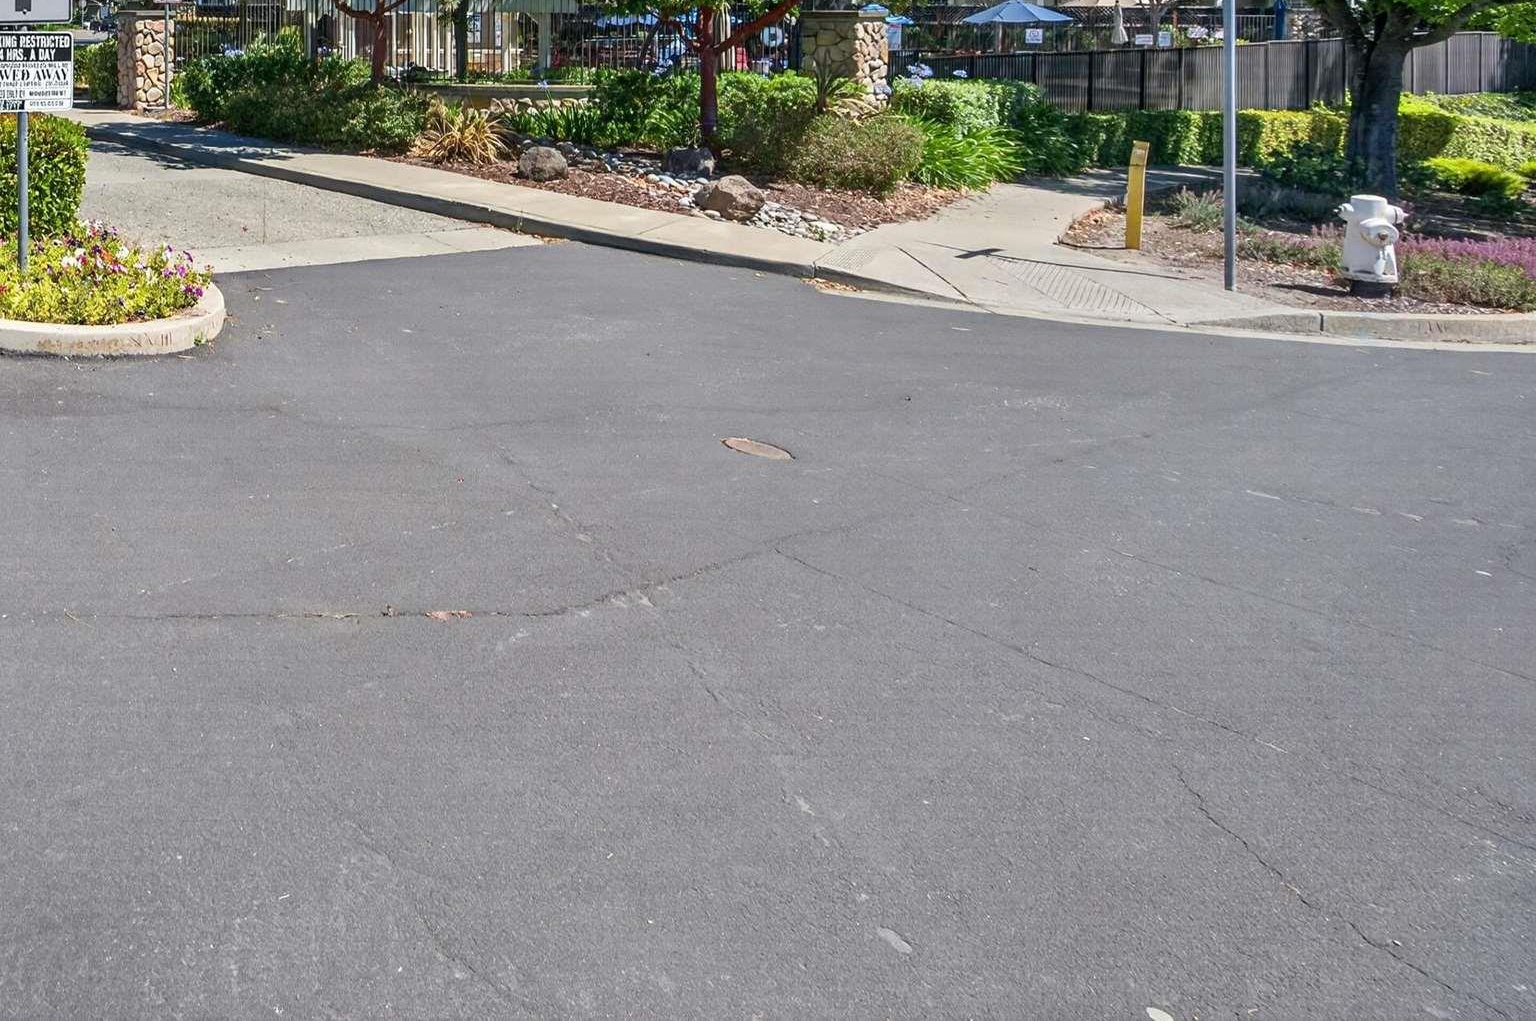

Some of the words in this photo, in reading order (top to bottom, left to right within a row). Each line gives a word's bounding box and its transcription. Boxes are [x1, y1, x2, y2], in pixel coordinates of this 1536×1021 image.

[19, 35, 70, 48] RESTRICTED
[29, 49, 38, 61] A
[38, 49, 56, 61] DAY
[35, 69, 69, 81] AWAY
